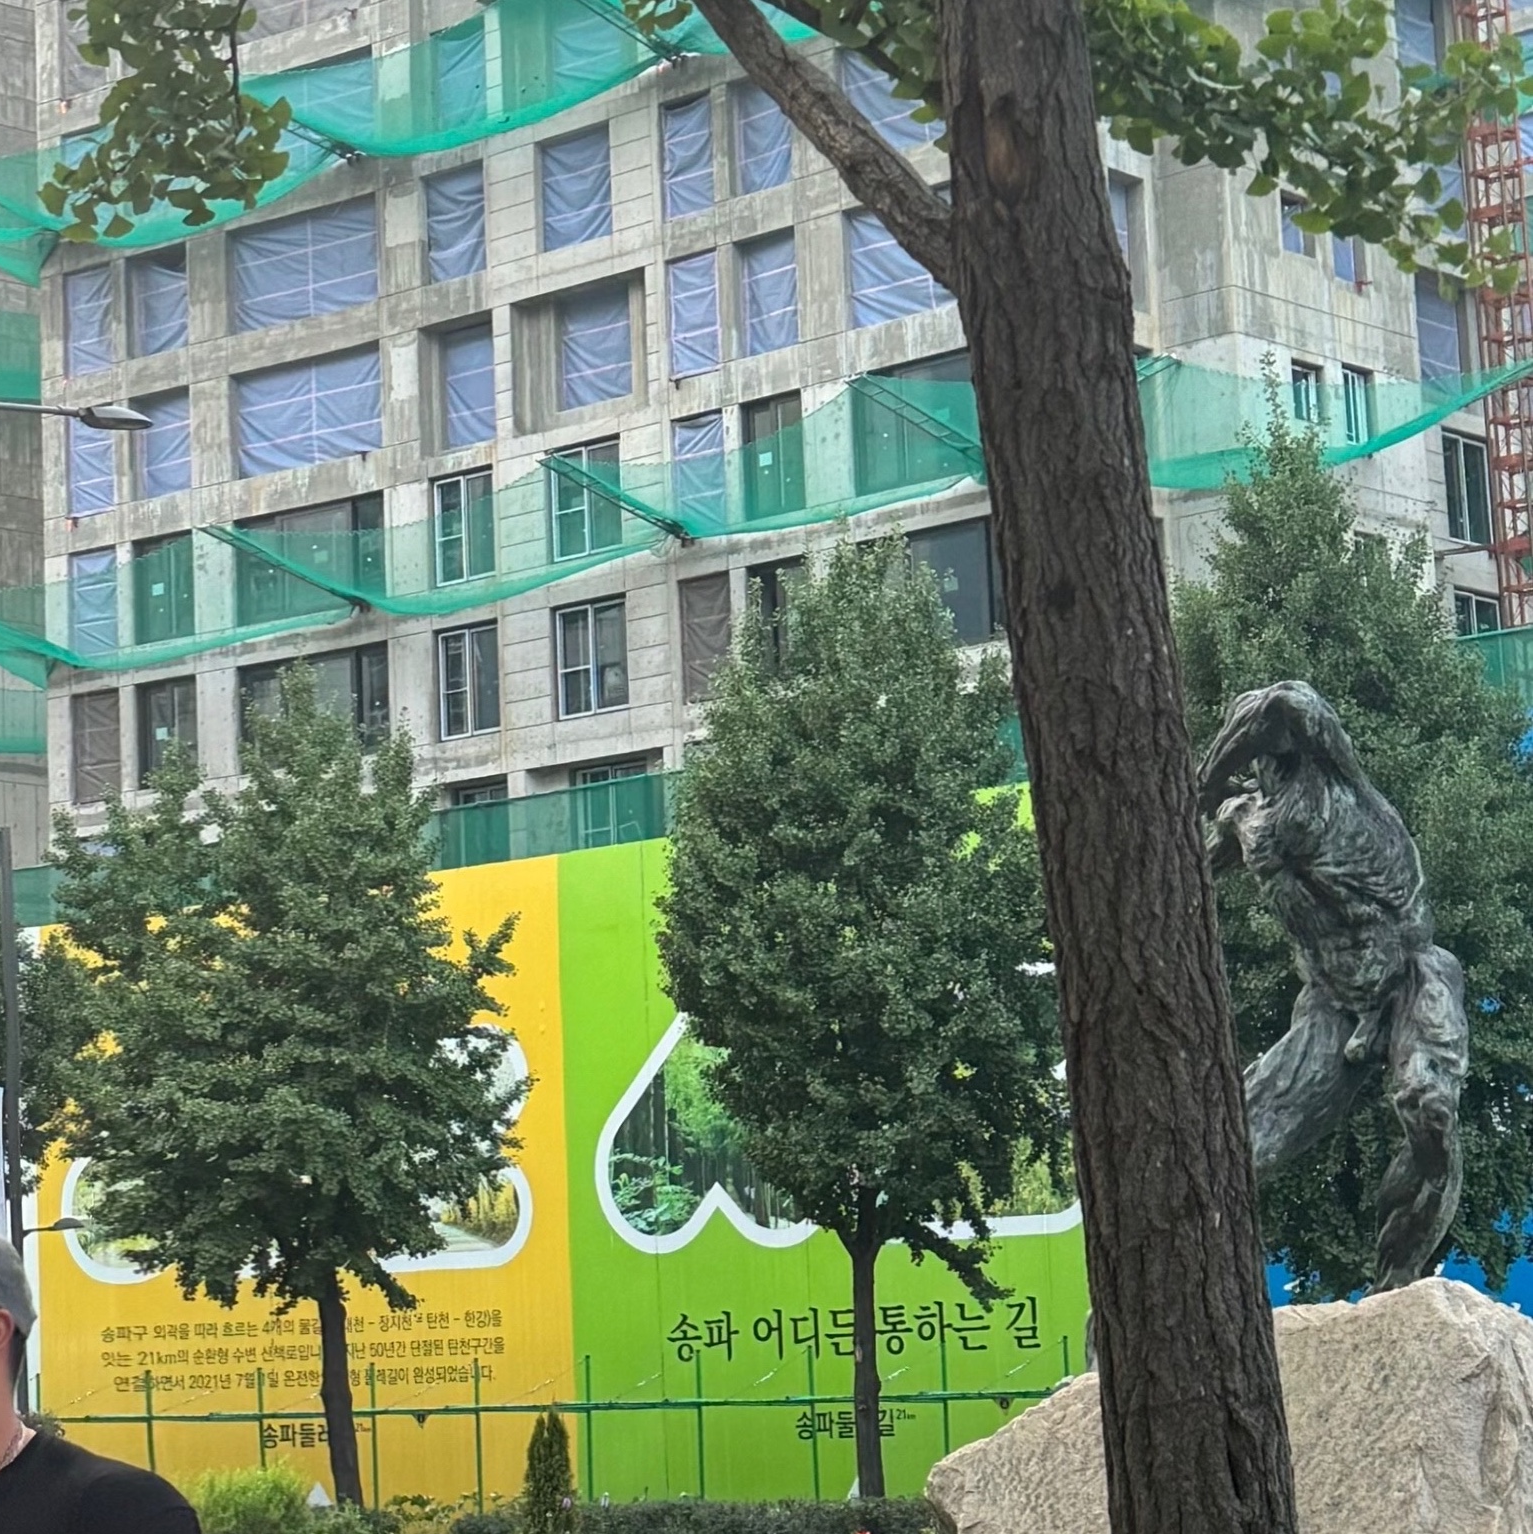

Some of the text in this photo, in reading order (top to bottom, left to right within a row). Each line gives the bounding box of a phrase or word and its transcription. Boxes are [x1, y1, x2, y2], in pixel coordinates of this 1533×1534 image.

[101, 1325, 148, 1342] 송파구
[154, 1323, 190, 1340] 외곽을
[194, 1322, 218, 1338] 따라
[222, 1321, 259, 1337] 흐르는
[378, 1313, 412, 1332] 장지천
[426, 1311, 449, 1329] 탄천
[666, 1296, 1042, 1362] 송파 어디든 통하는 길
[101, 1351, 133, 1367] 잇는
[137, 1350, 189, 1366] 21km의
[193, 1348, 228, 1365] 순환형
[232, 1347, 256, 1364] 수변
[261, 1344, 321, 1362] 산책로입니
[370, 1341, 406, 1358] 50년간
[410, 1339, 443, 1357] 단절된
[189, 1373, 231, 1389] 2021년
[283, 1370, 320, 1387] 온전한
[263, 1423, 328, 1448] 송파둘
[795, 1407, 895, 1440] 송파둘길
